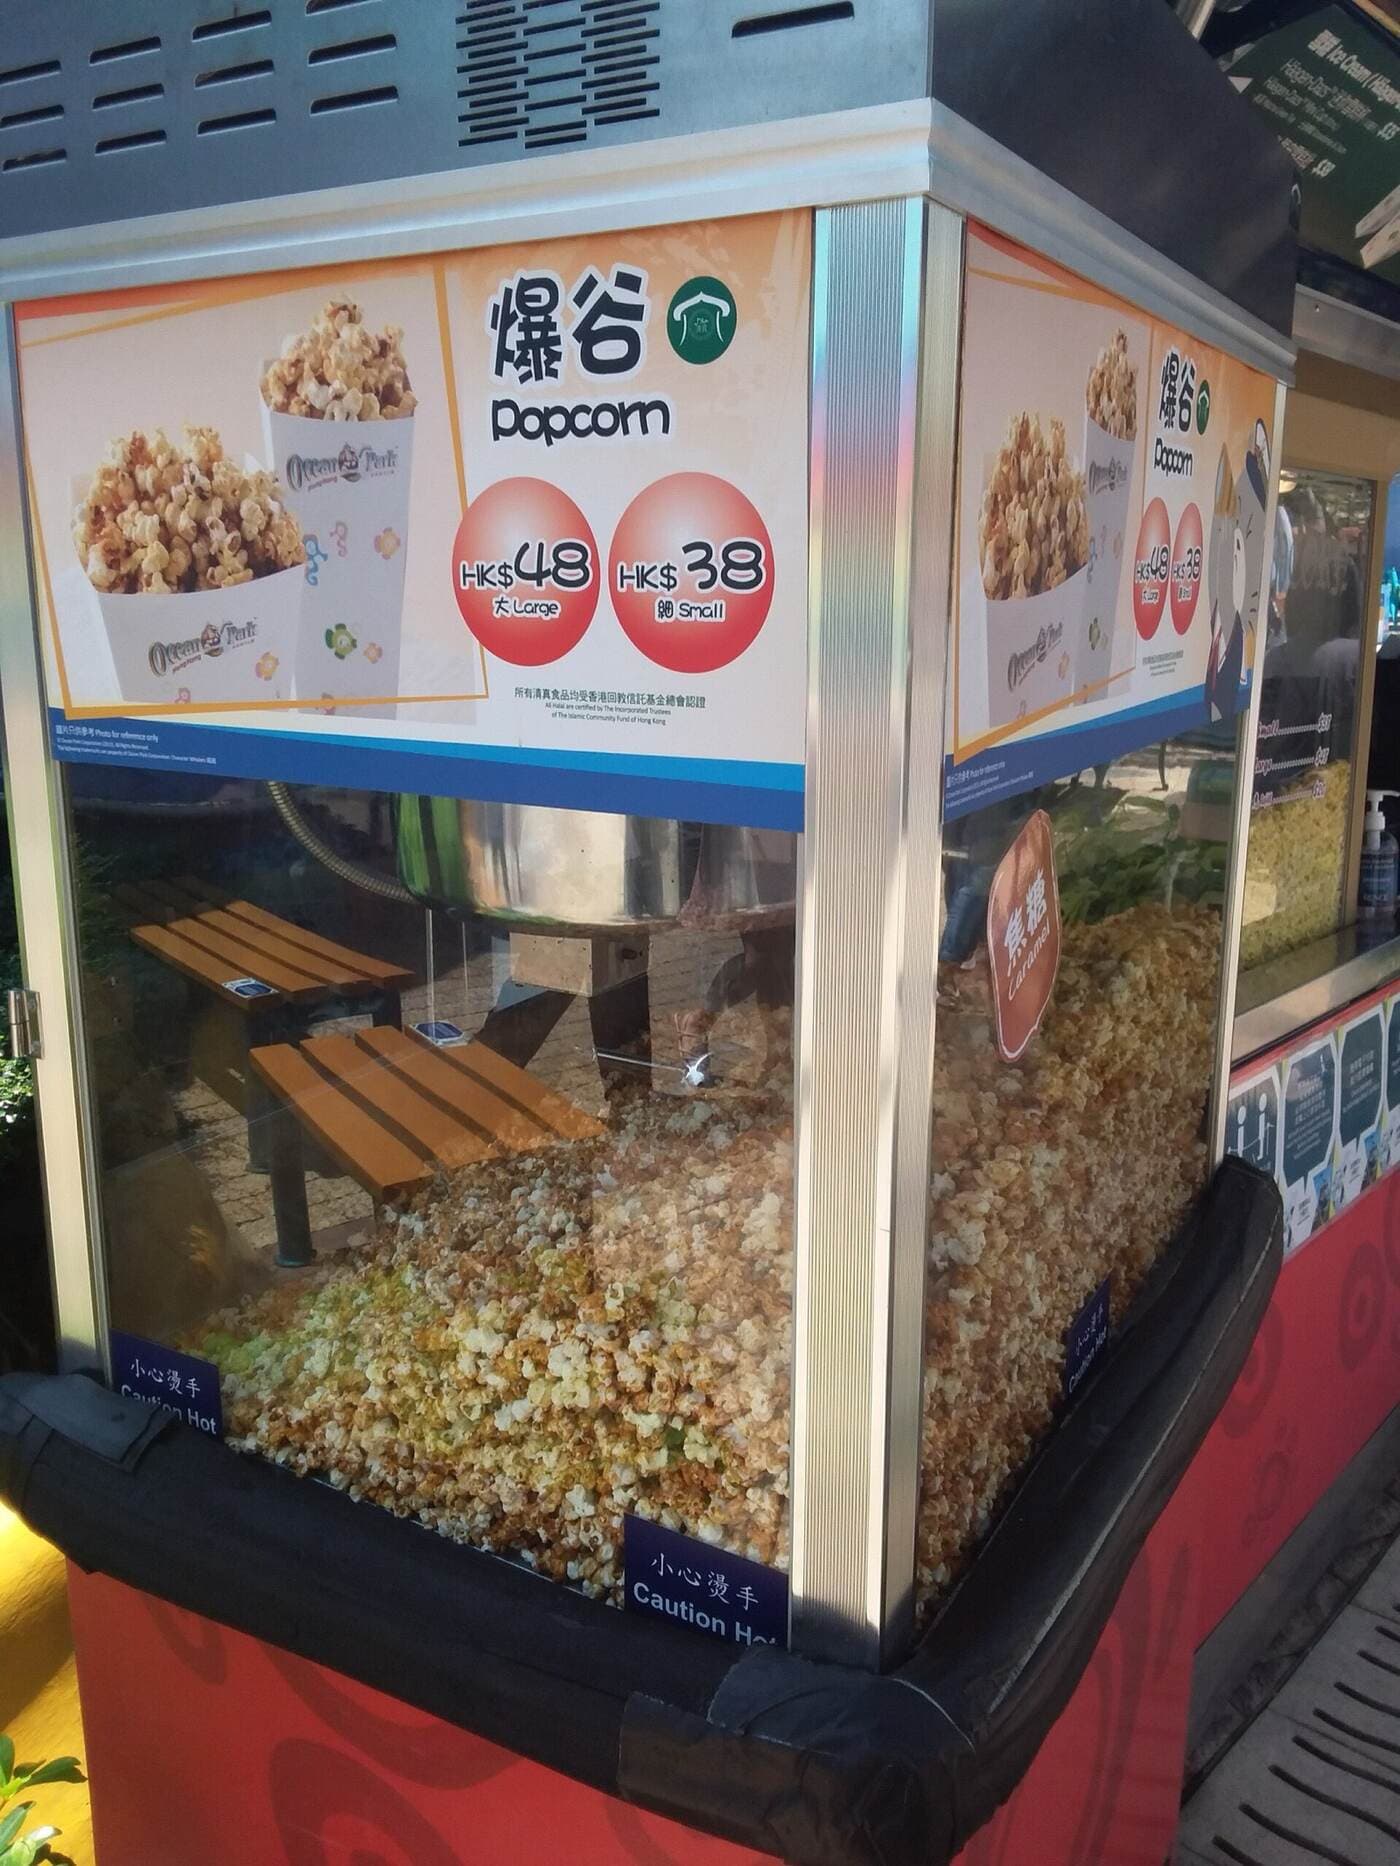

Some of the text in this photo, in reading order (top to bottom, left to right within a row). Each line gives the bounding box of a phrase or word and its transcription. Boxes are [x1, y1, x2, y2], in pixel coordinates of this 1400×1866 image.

[490, 271, 646, 385] 爆谷
[1158, 351, 1195, 433] 爆谷
[491, 398, 671, 447] Popcorn
[1153, 437, 1193, 477] Popcorn
[494, 597, 559, 616] 大 Large
[657, 599, 724, 620] 細 Small
[574, 703, 596, 711] certified
[614, 705, 648, 714] Incorporated
[586, 713, 616, 722] Community
[1008, 917, 1051, 1001] Caramel
[130, 1358, 201, 1399] 小心燙手
[187, 1407, 217, 1435] Hot
[650, 1552, 759, 1611] 小心燙手
[633, 1581, 726, 1636] Caution
